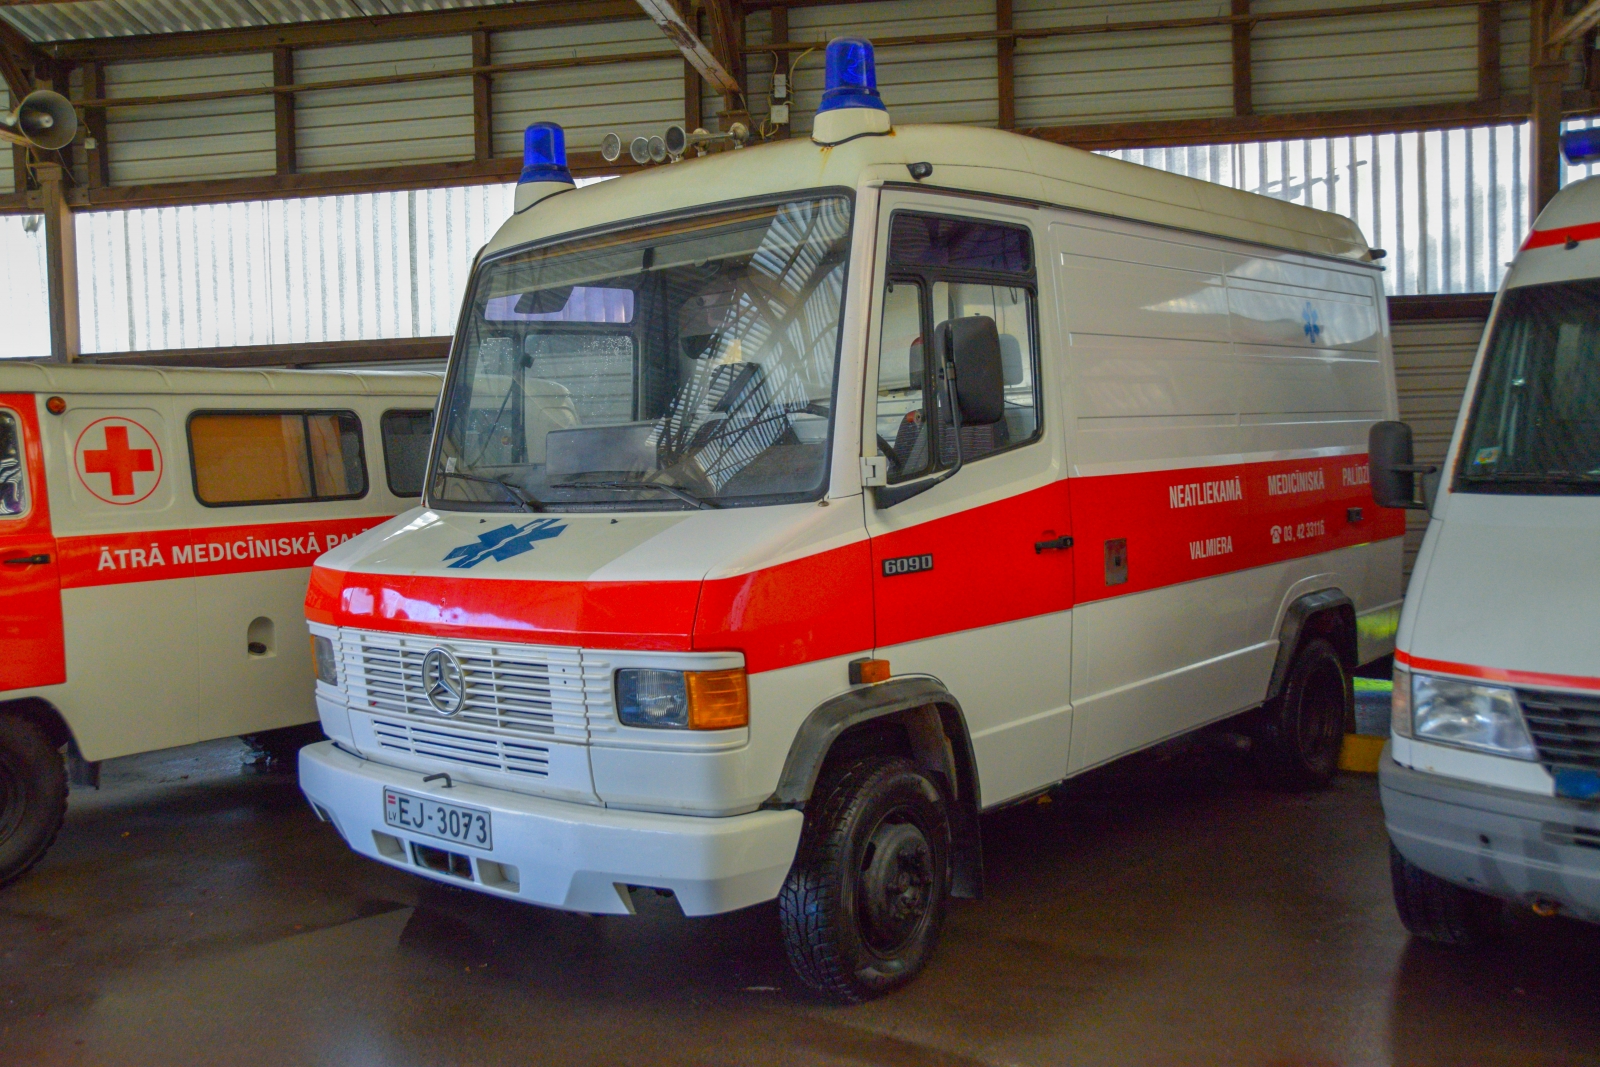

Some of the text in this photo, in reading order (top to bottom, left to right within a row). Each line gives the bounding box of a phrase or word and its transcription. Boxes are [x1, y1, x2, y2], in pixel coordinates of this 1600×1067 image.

[1169, 476, 1243, 509] NEATLIEKAMĀ
[1267, 467, 1325, 496] MEDICĪNISKĀ
[98, 543, 165, 571] ĀTRĀ
[172, 532, 321, 565] MEDICĪNISKĀ
[1189, 536, 1233, 560] VALMIERA
[388, 810, 397, 822] LV
[398, 797, 487, 844] EJ-3073
